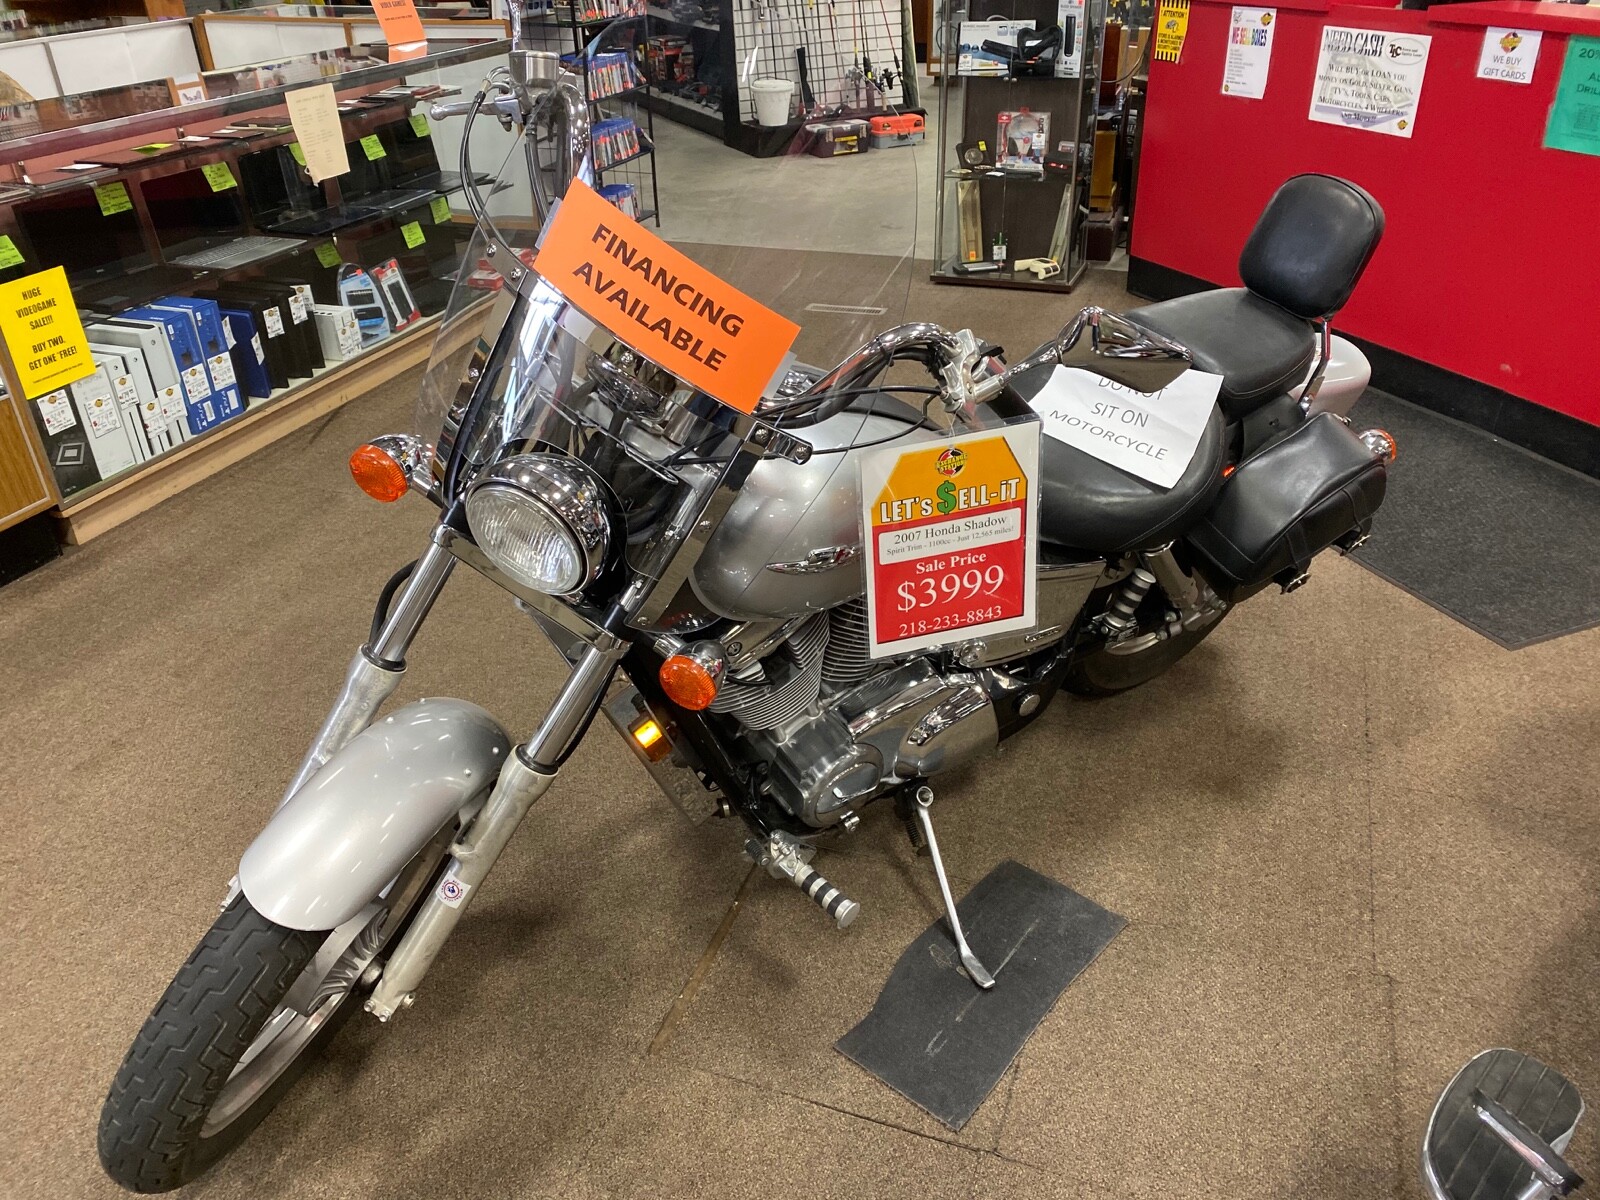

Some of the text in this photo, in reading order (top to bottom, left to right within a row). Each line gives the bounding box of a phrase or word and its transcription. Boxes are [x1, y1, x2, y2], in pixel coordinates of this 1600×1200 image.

[1232, 26, 1268, 46] WE SELL BOXES
[1324, 29, 1353, 53] NEED
[1493, 56, 1522, 66] WE BUY
[1346, 66, 1360, 78] BUY
[1371, 69, 1391, 79] LOAN
[1484, 67, 1526, 80] GIFT CARDS
[1576, 84, 1600, 96] DRIL
[591, 223, 745, 338] FINANCING
[22, 286, 41, 300] HUGE
[16, 298, 57, 318] VIDEOGAME
[572, 261, 728, 372] AVAILABLE
[29, 315, 54, 330] SALE!!!
[32, 342, 47, 354] BUY
[29, 358, 42, 370] GET
[44, 353, 57, 366] ONE
[1091, 402, 1149, 427] SIT ON
[1050, 410, 1168, 461] MOTORCYCLE
[935, 453, 968, 468] EXCHANGE
[939, 460, 964, 473] STATION
[894, 516, 1007, 545] 2007 Honda Shadow
[886, 547, 905, 556] Spirit
[907, 544, 922, 552] Trim
[929, 539, 950, 548] 1100cc
[957, 535, 970, 543] Just
[972, 530, 993, 541] 12,565
[994, 526, 1014, 535] miles!
[916, 553, 986, 575] Sale Price
[897, 564, 1004, 613] $3999
[899, 605, 1002, 637] 218-233-8843
